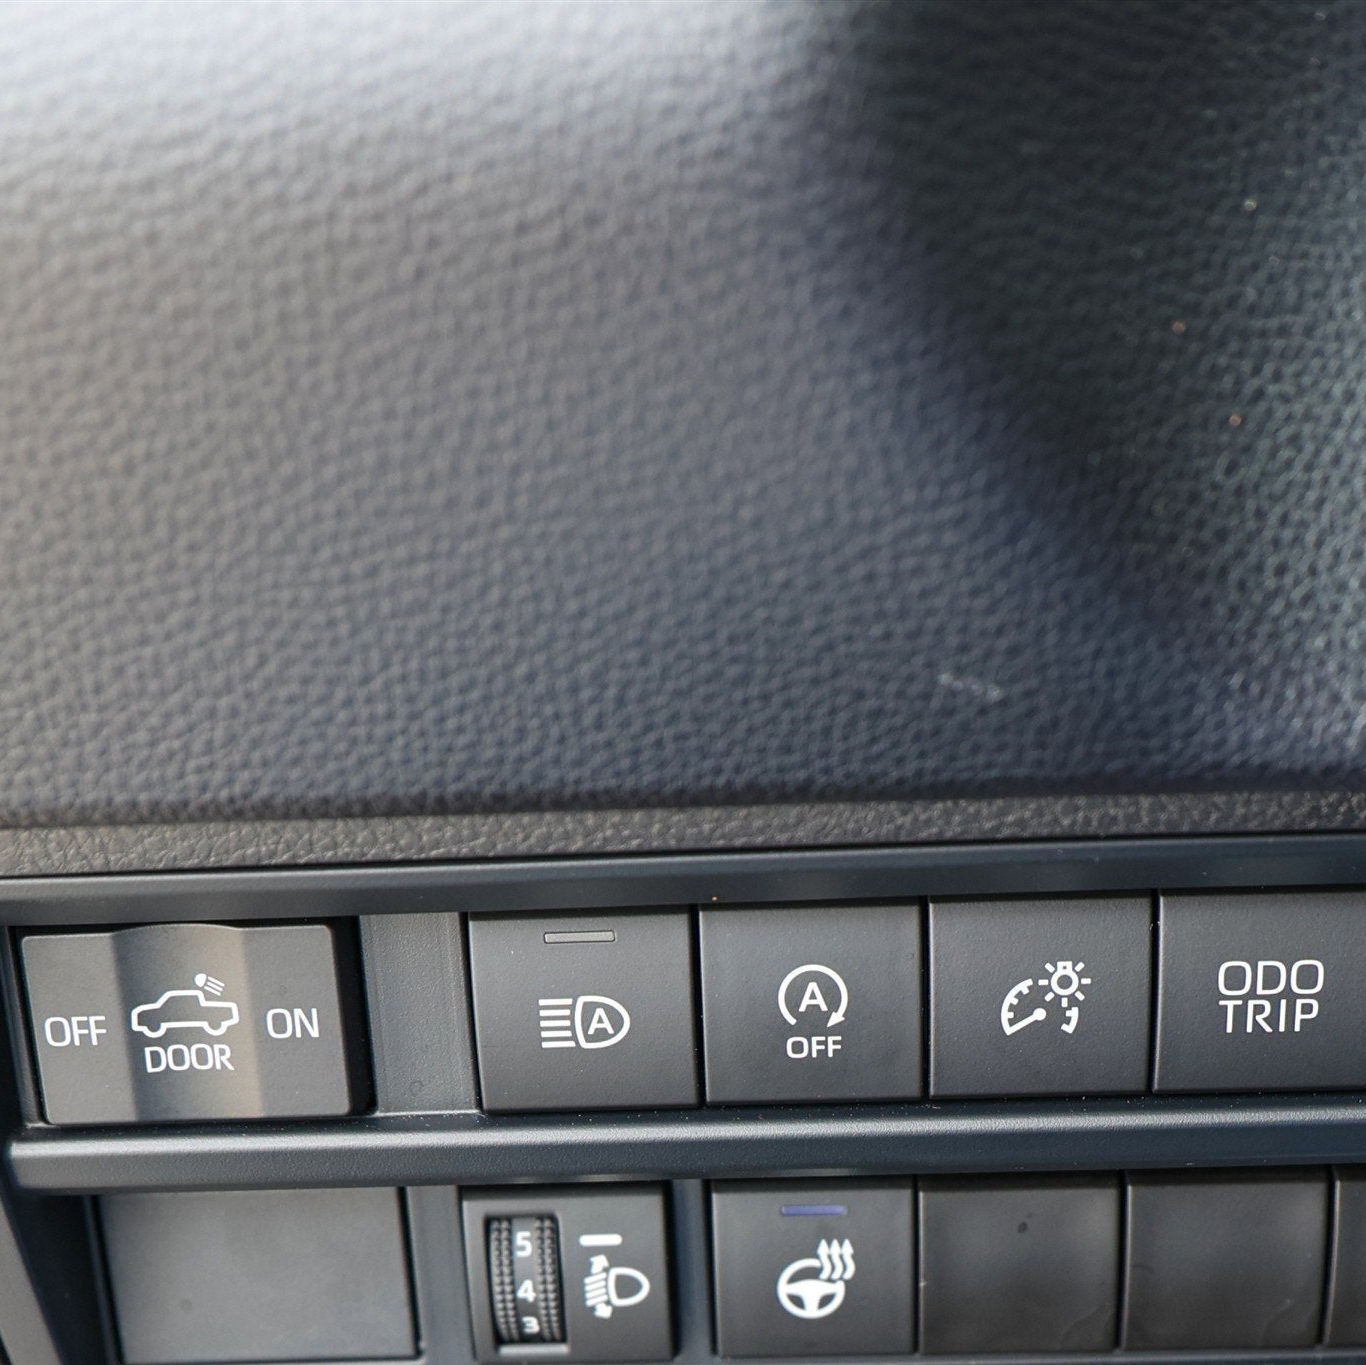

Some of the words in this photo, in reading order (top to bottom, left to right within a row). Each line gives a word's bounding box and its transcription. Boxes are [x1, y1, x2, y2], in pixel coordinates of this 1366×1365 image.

[1217, 959, 1325, 996] ODO
[798, 981, 829, 1013] A
[44, 1015, 108, 1047] OFF
[266, 1007, 320, 1039] ON
[588, 1007, 616, 1035] A
[1218, 998, 1320, 1034] TRIP
[144, 1043, 236, 1073] DOOR
[786, 1035, 843, 1059] OFF
[515, 1230, 533, 1258] 5
[516, 1278, 537, 1304] 4
[522, 1315, 541, 1334] 3
